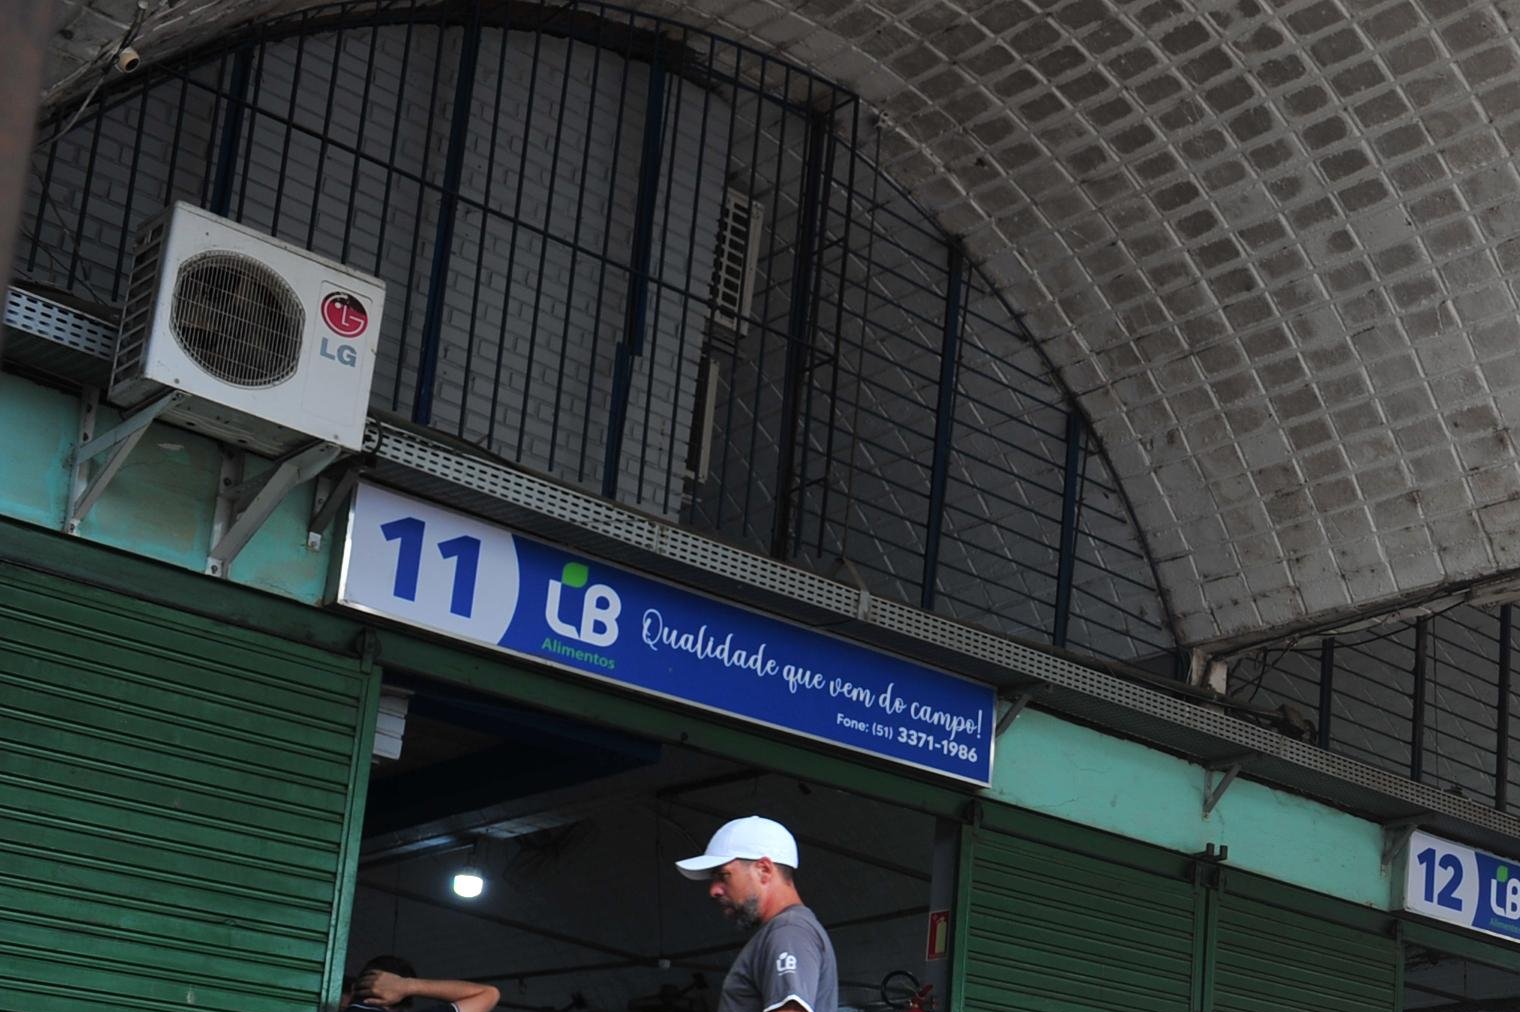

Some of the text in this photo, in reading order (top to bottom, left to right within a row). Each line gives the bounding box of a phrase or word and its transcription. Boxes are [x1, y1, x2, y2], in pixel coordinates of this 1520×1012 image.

[320, 337, 357, 367] LG
[380, 516, 481, 619] 11
[545, 577, 622, 647] LB
[541, 637, 616, 670] Alimentos
[642, 608, 983, 741] Qualidade que vem do campo!
[836, 713, 978, 763] Fone: (51) 3371-1986
[1416, 847, 1464, 912] 12
